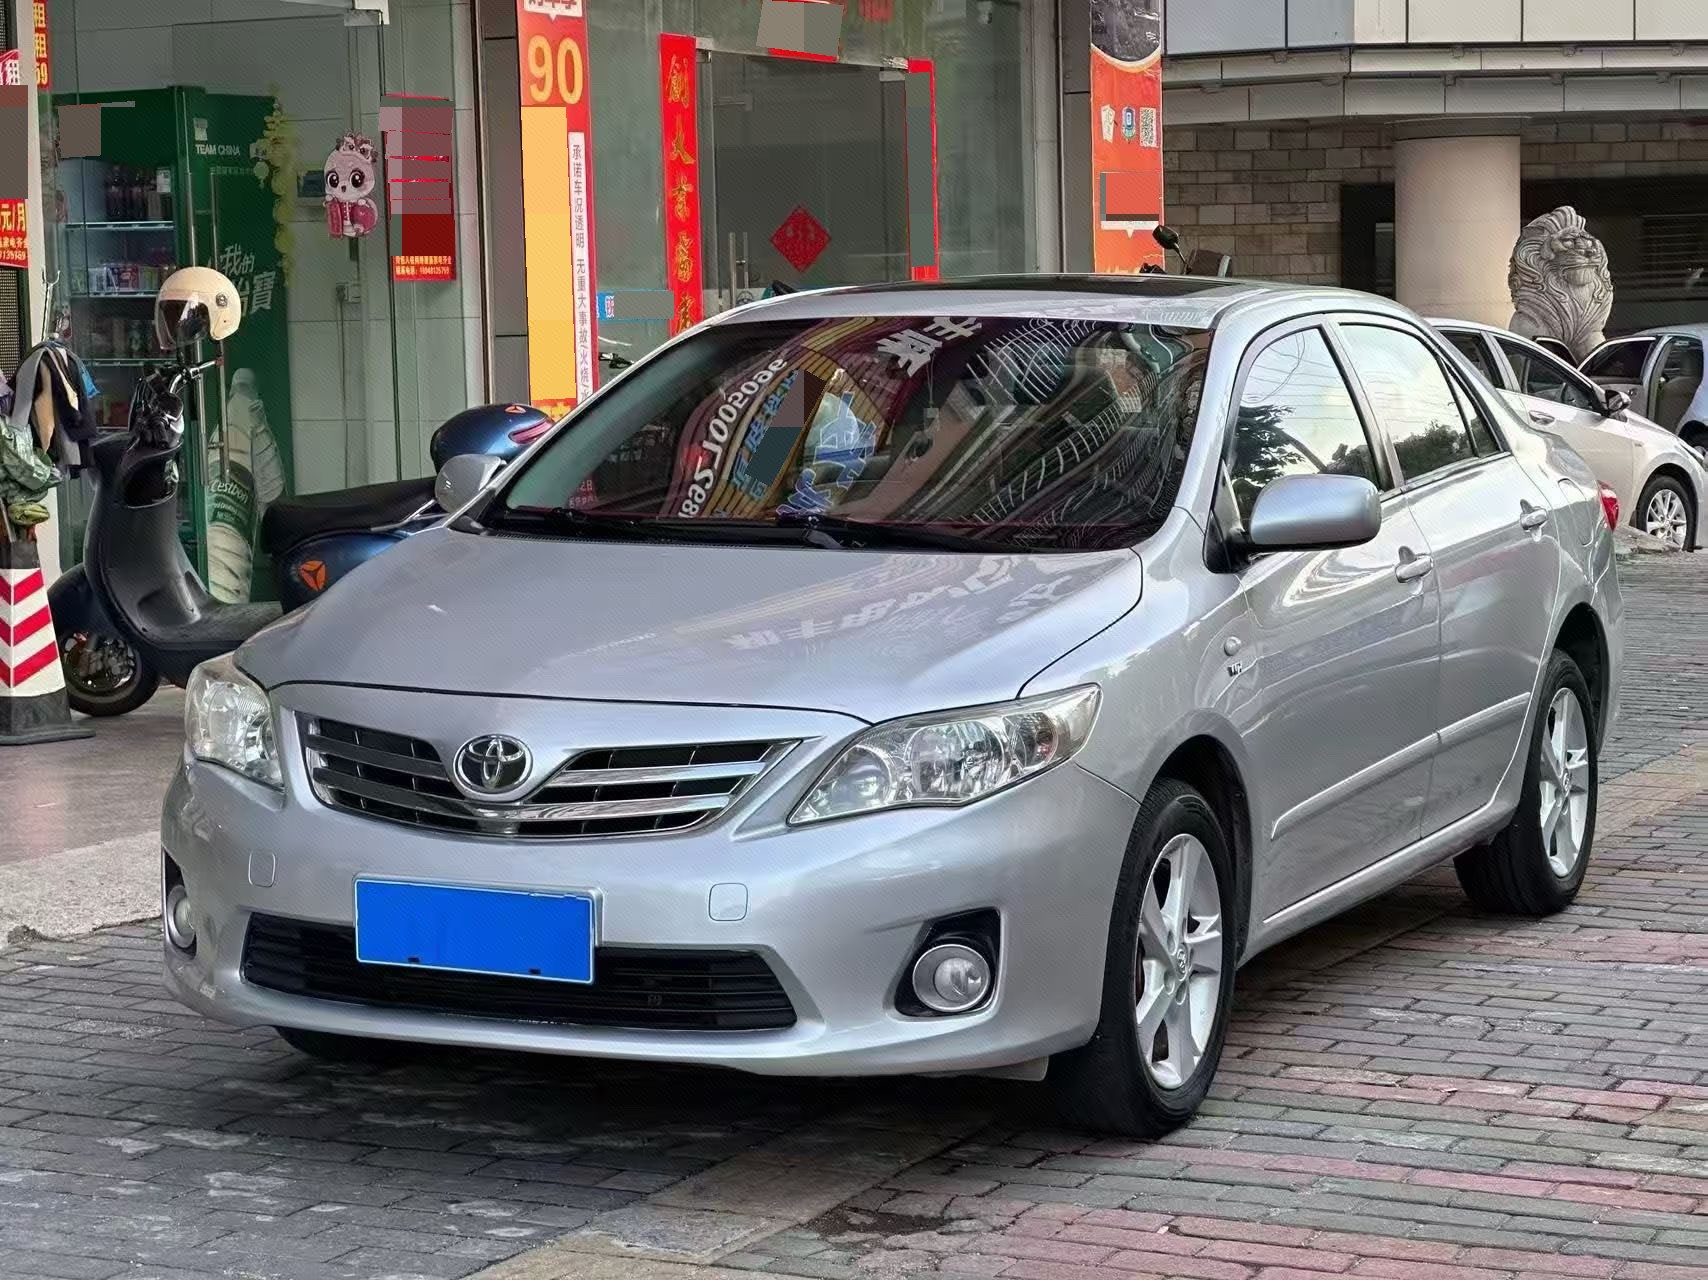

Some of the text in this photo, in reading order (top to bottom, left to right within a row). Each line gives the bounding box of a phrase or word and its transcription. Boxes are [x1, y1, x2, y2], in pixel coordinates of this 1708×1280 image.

[527, 34, 583, 105] 90
[195, 144, 241, 156] TEAM CHINA
[572, 143, 585, 249] 承诺车况透明
